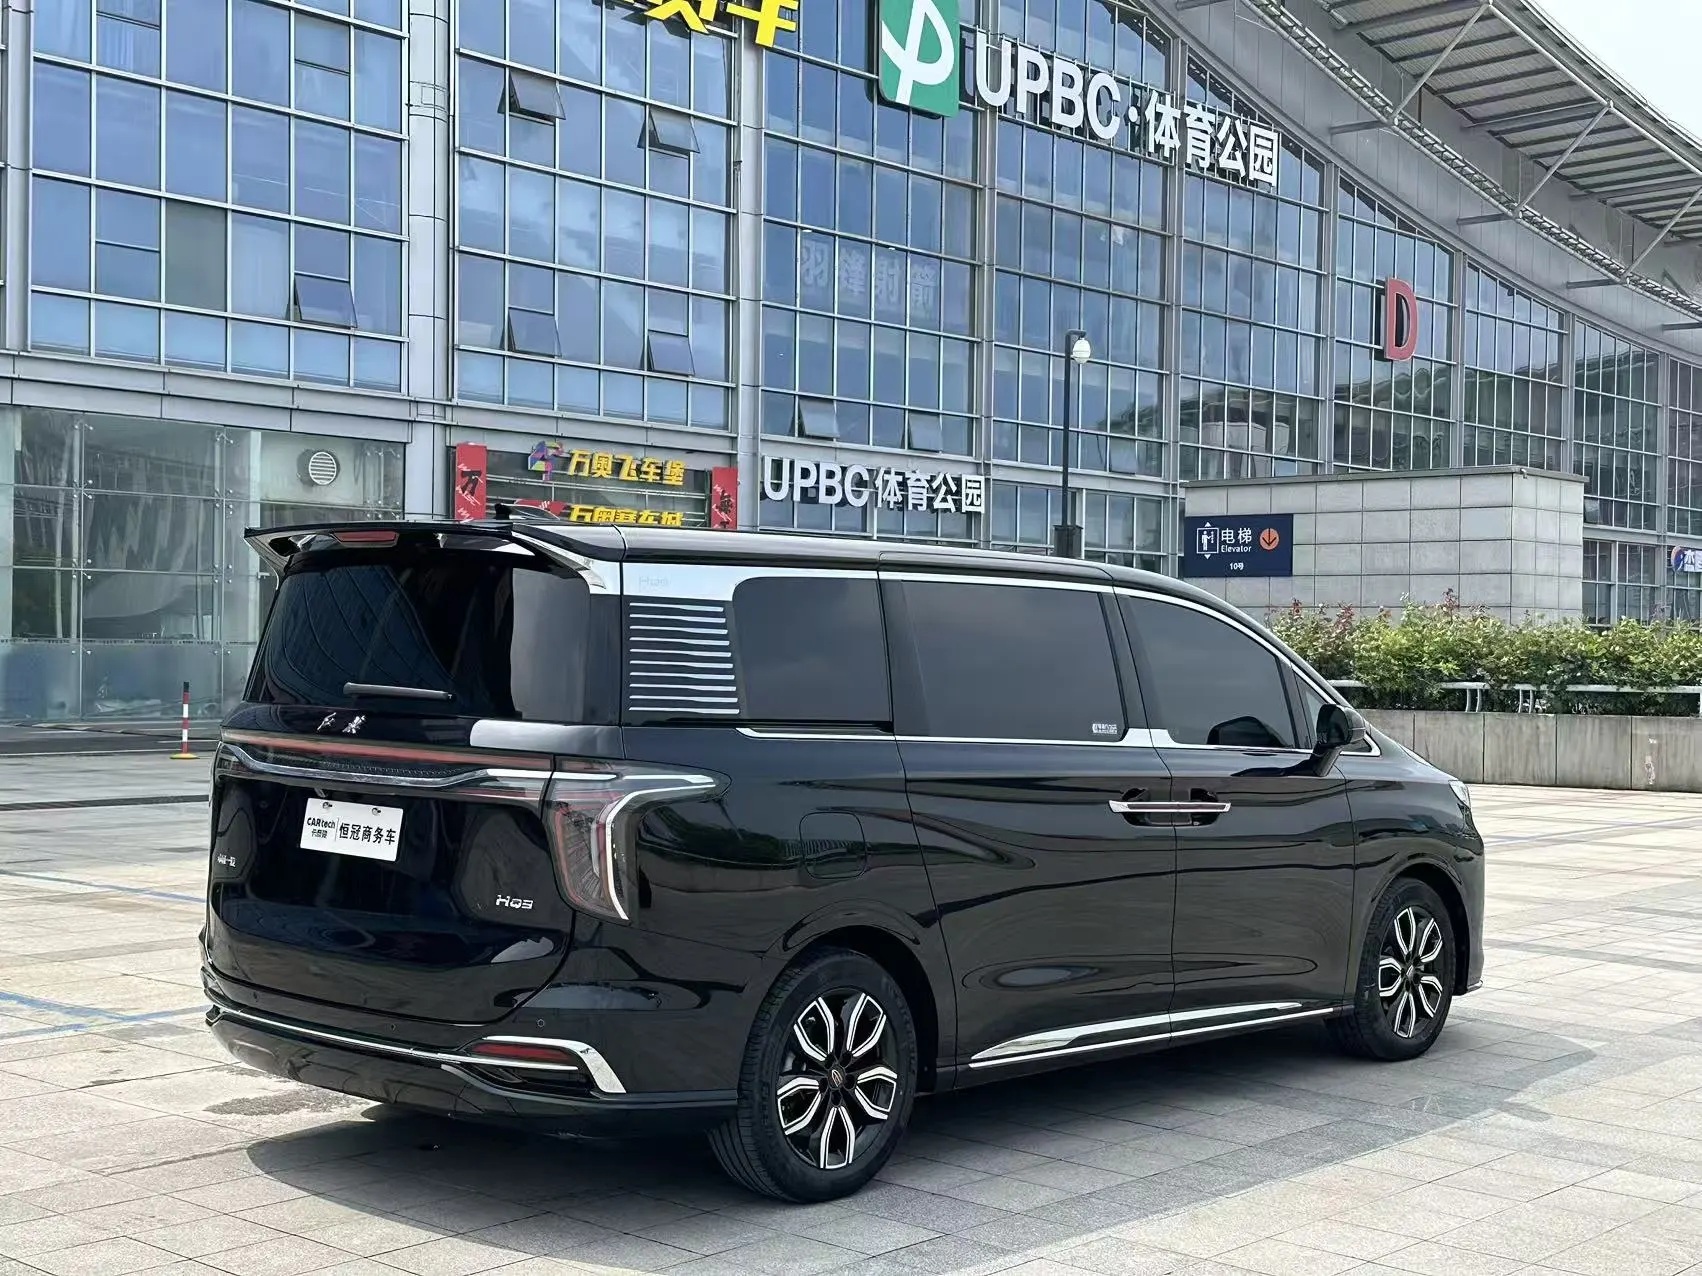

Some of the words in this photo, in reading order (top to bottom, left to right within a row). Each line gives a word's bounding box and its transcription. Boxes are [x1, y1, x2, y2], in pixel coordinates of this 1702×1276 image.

[1384, 277, 1418, 361] D
[568, 450, 685, 486] 万奥飞车堡
[1221, 528, 1252, 544] 电梯
[1221, 544, 1252, 553] Elevator
[338, 822, 397, 845] 恒冠商务车
